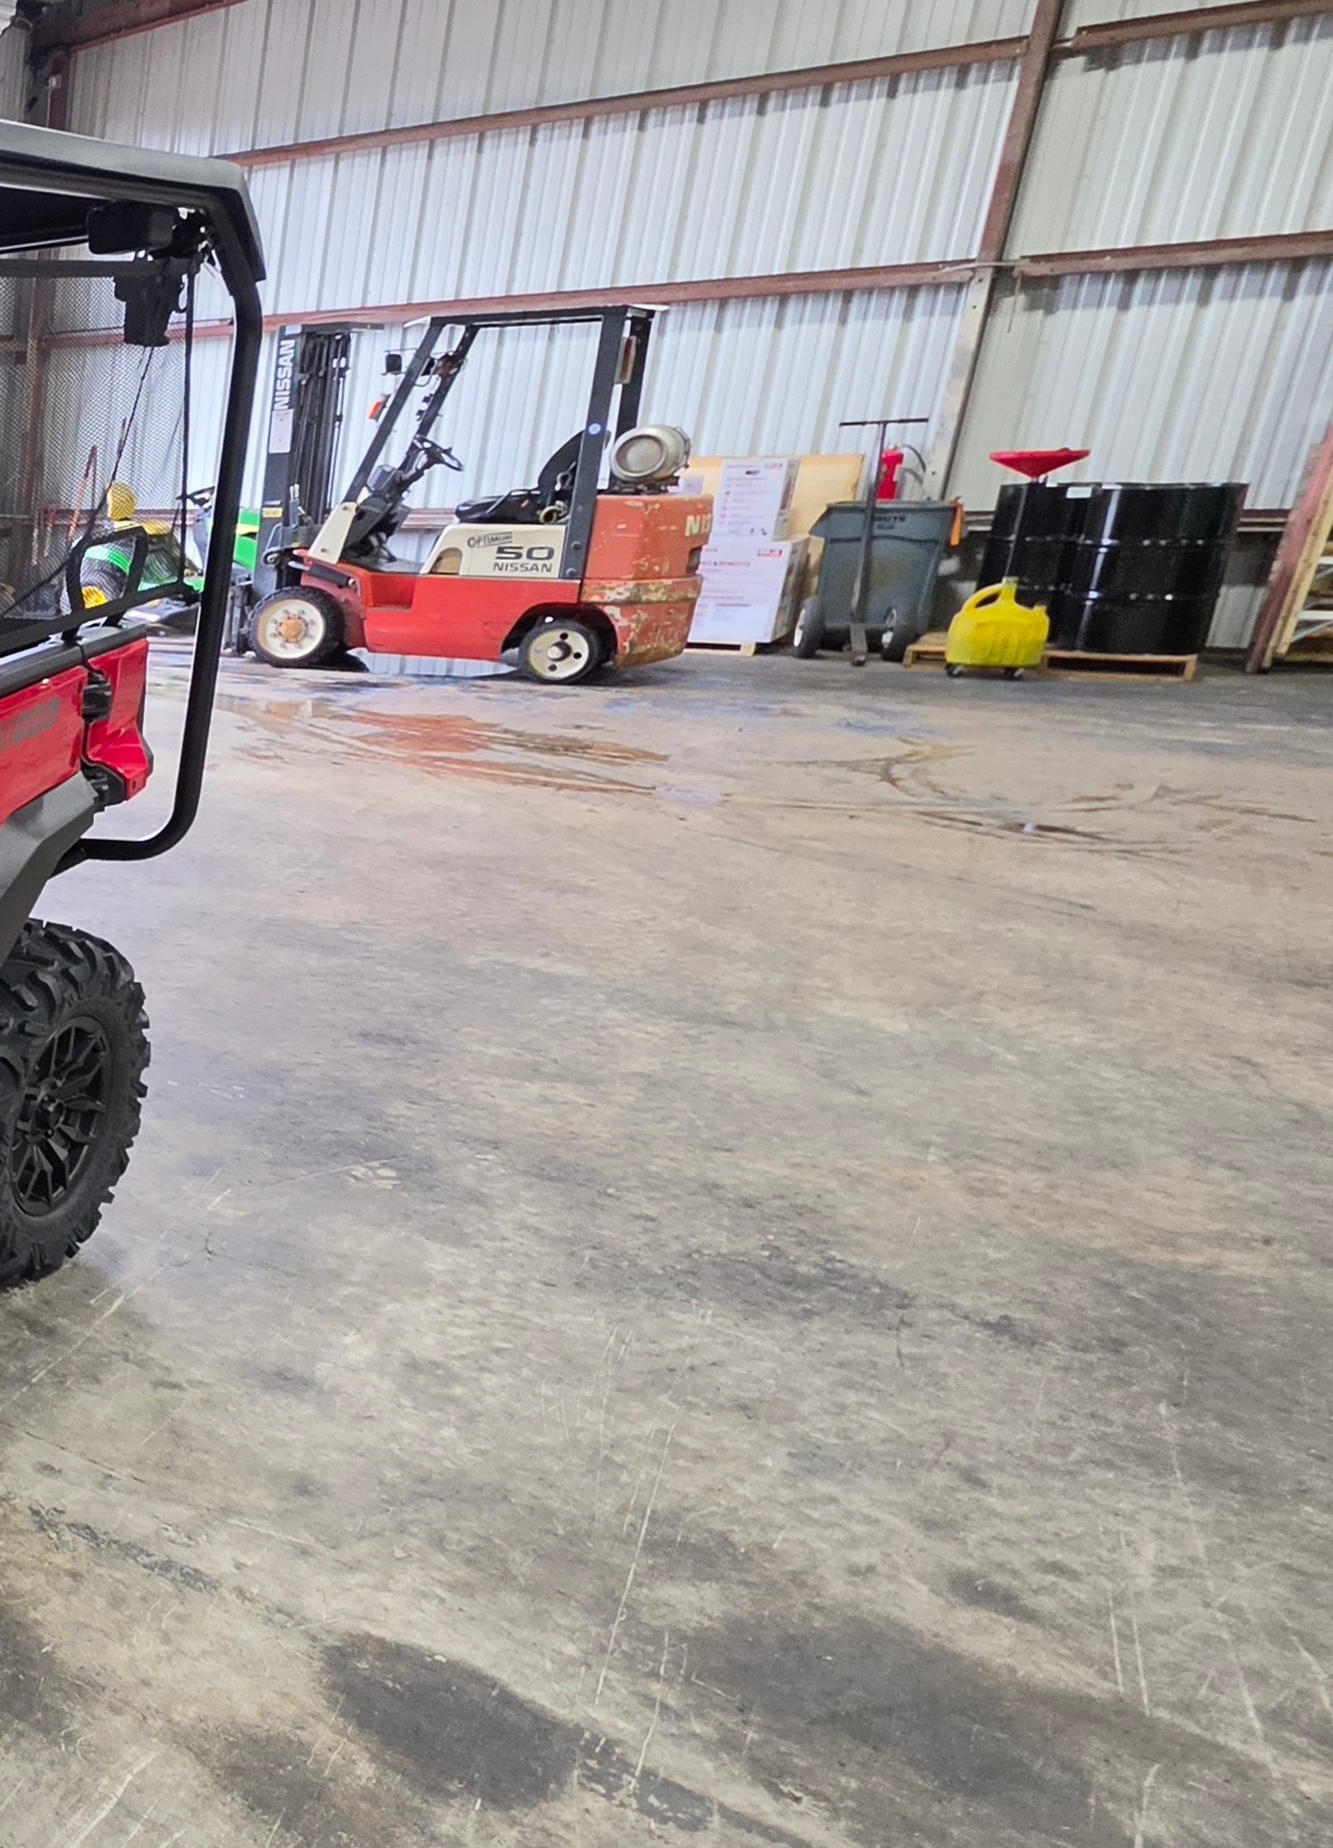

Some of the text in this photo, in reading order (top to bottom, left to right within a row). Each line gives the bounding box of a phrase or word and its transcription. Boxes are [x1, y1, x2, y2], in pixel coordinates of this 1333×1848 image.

[274, 339, 295, 410] NISSAN
[495, 546, 555, 561] 50
[494, 562, 553, 573] NISSAN
